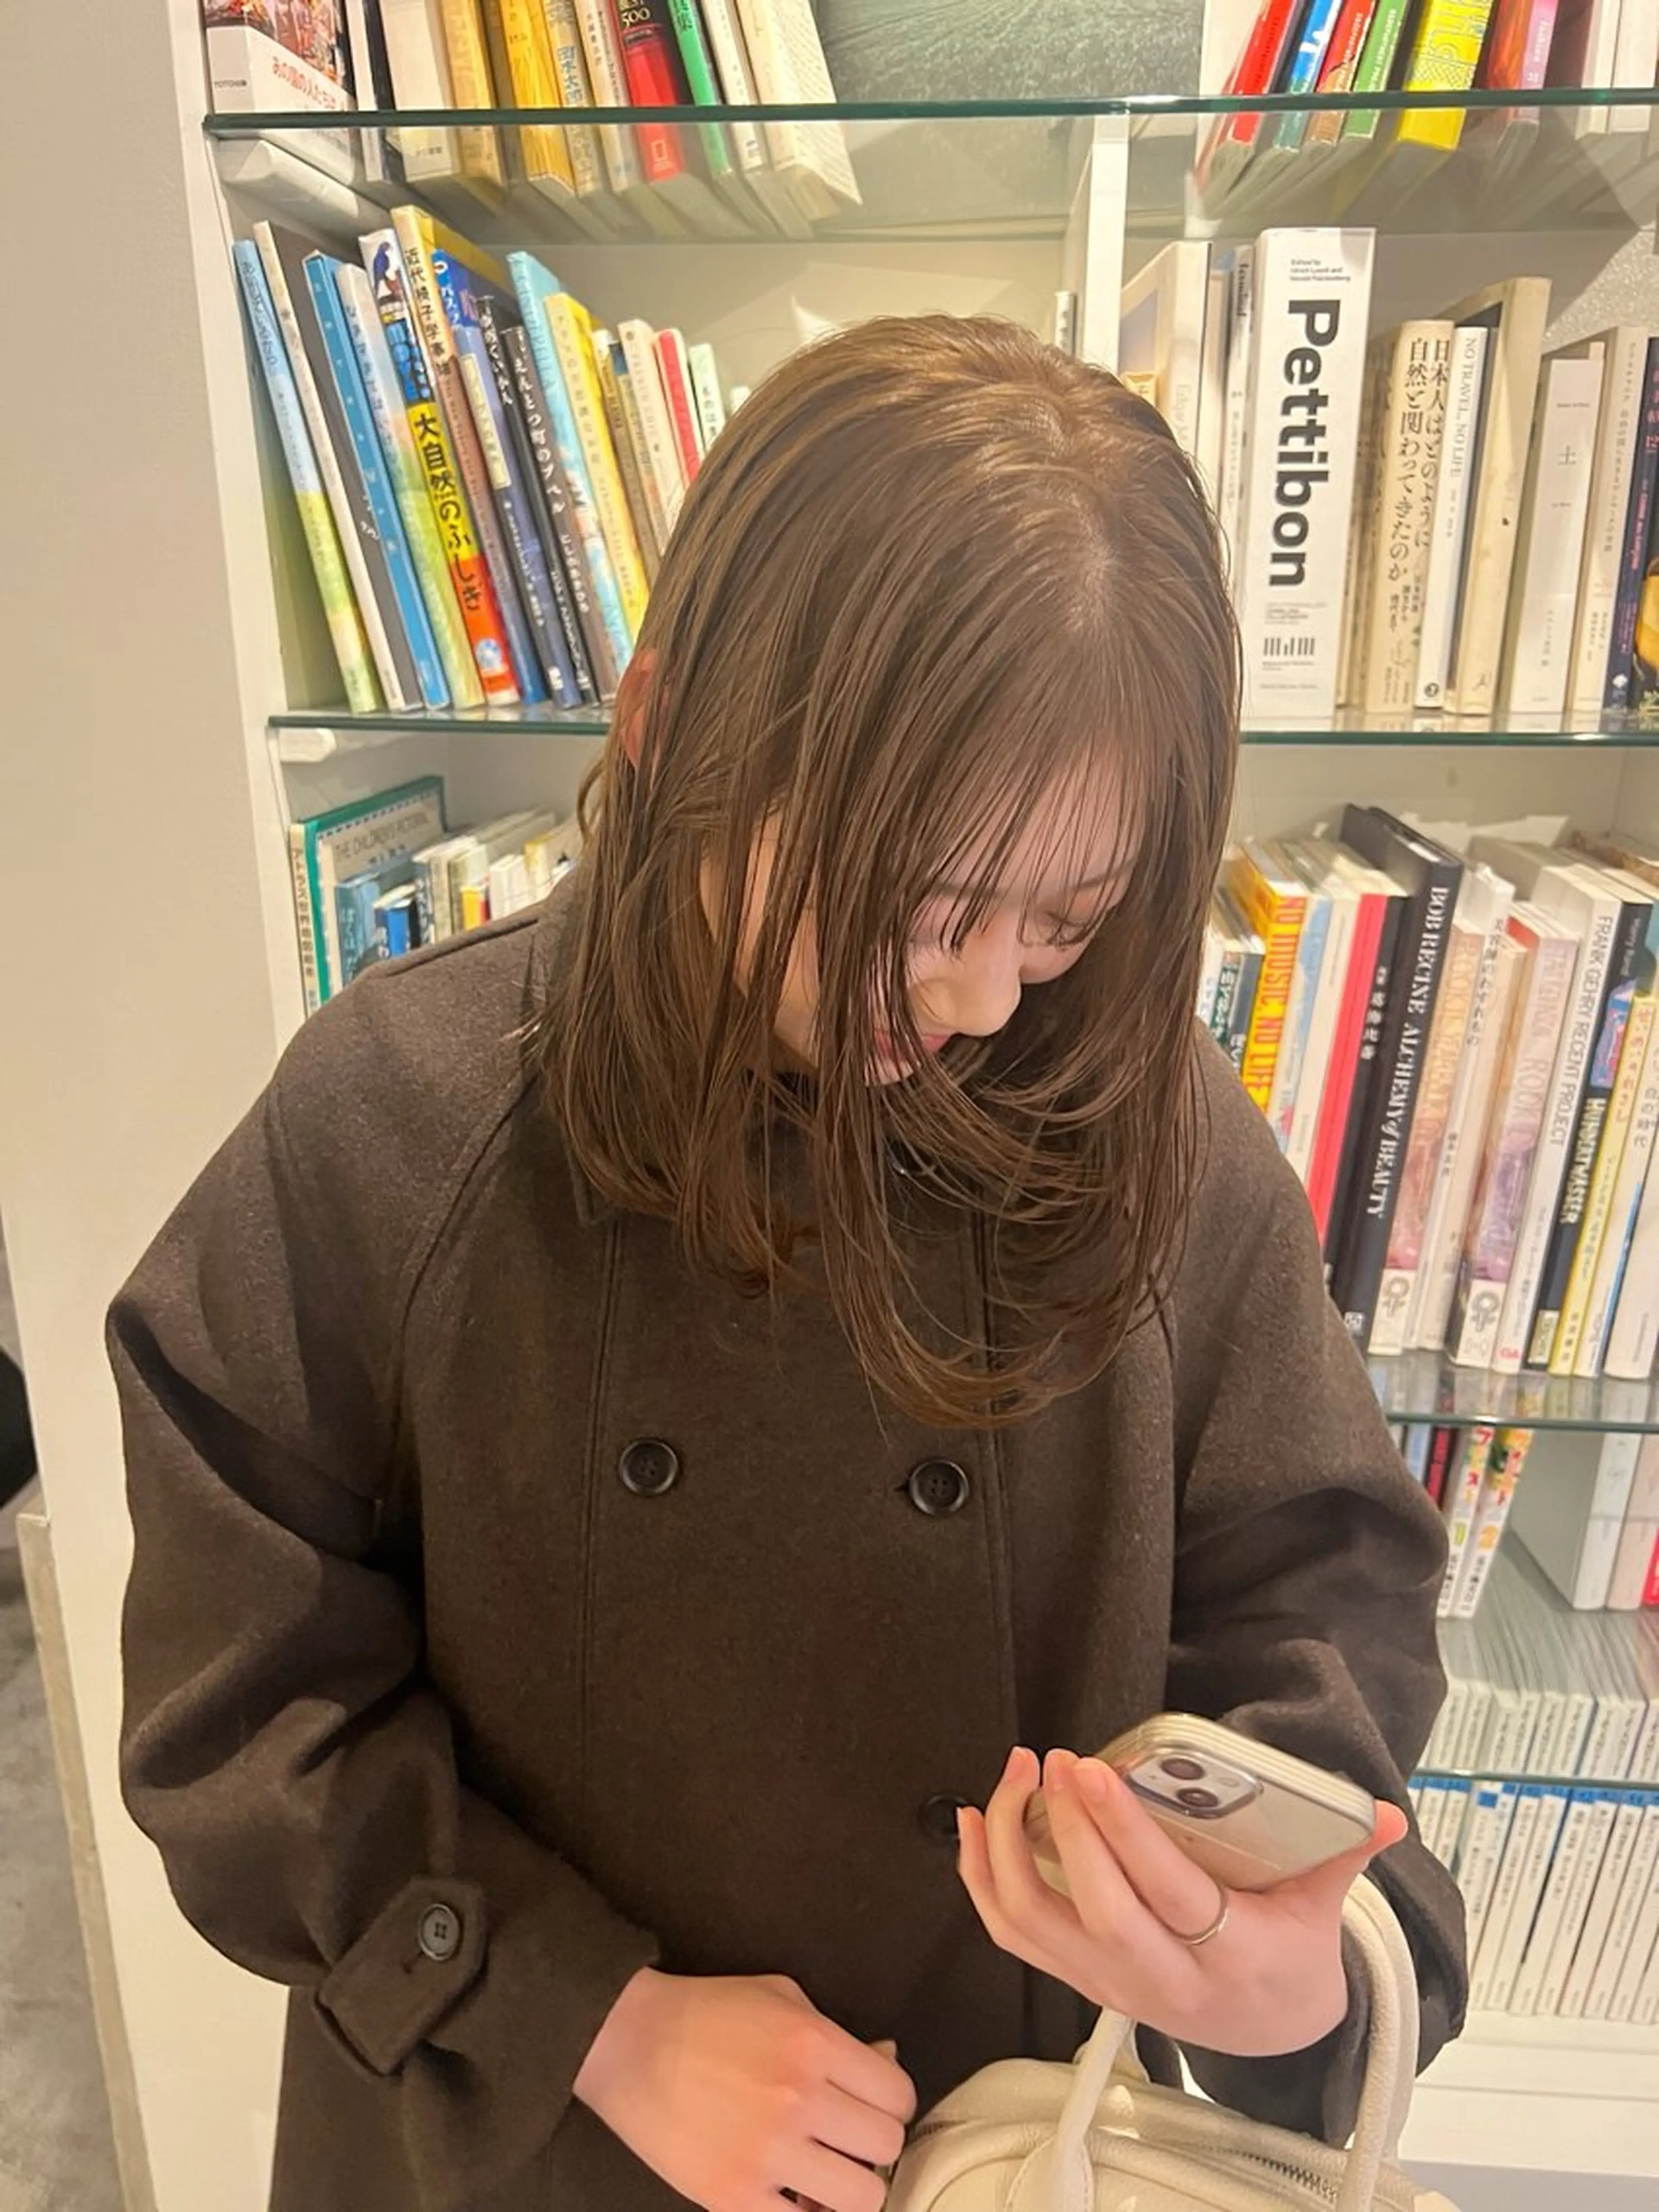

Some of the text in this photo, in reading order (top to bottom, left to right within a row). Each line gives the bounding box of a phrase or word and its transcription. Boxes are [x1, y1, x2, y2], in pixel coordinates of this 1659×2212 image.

[622, 7, 650, 27] 500
[1464, 338, 1477, 358] NO
[514, 356, 566, 513] えんとつ町のプペル
[1269, 299, 1341, 586] Pettibon
[1388, 338, 1428, 581] 自然と関わってきたのか
[1414, 340, 1449, 547] 日本人はどのように
[1450, 446, 1465, 476] LIFE
[1454, 424, 1468, 445] NO
[414, 413, 481, 610] 大自然のふしぎ
[1278, 898, 1305, 925] NO
[1426, 886, 1449, 930] BOB
[1408, 932, 1439, 1014] RECINE
[1254, 1015, 1282, 1046] NO
[1386, 1022, 1422, 1119] ALCHEMY
[1548, 915, 1613, 1147] FRANK GEHRY RECENT PROJECT
[1367, 1138, 1397, 1217] BEAUTY
